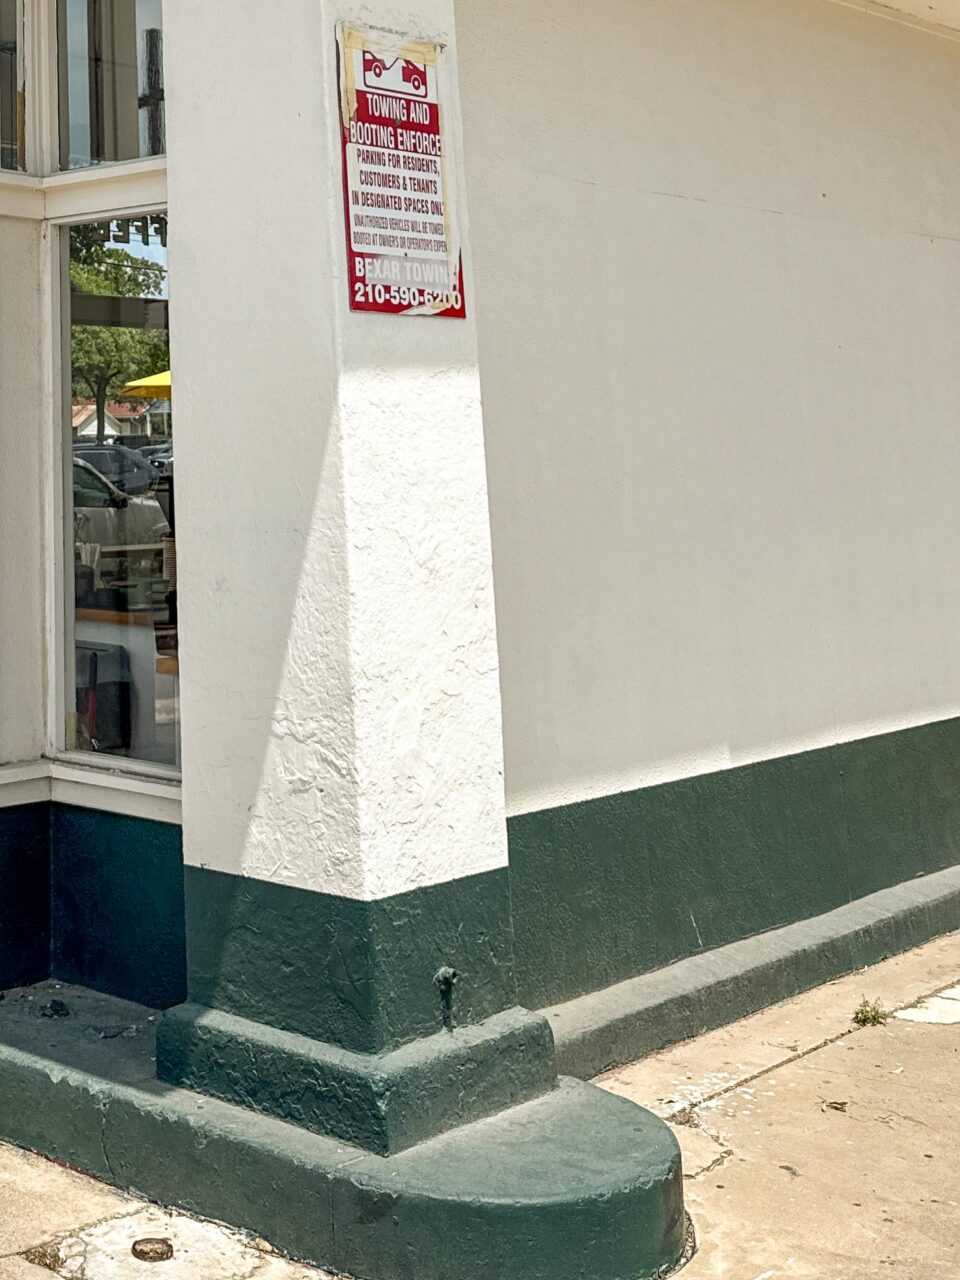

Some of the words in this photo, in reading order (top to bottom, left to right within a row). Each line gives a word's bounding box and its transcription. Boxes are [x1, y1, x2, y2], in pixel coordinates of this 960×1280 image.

[366, 93, 407, 121] TOWING
[410, 101, 430, 125] AND
[349, 120, 395, 148] BOOTING
[397, 128, 441, 155] ENFORCE
[357, 148, 386, 166] PARKING
[388, 153, 401, 169] FOR
[360, 170, 400, 190] CUSTOMERS
[402, 175, 408, 191] &
[409, 176, 438, 195] TENANTS
[352, 190, 360, 206] IN
[361, 191, 402, 211] DESIGNATED
[404, 197, 429, 214] SPACES
[431, 200, 444, 216] ONL
[354, 213, 388, 230] UNAUTHORIZED
[389, 217, 410, 232] VEHICLES
[410, 220, 422, 234] WILL
[422, 221, 428, 234] BE
[353, 231, 371, 245] BOOTED
[372, 233, 378, 246] AT
[400, 236, 406, 249] OR
[433, 239, 447, 253] EXPEN
[354, 256, 400, 280] BEXAR
[404, 261, 448, 284] TOWIN
